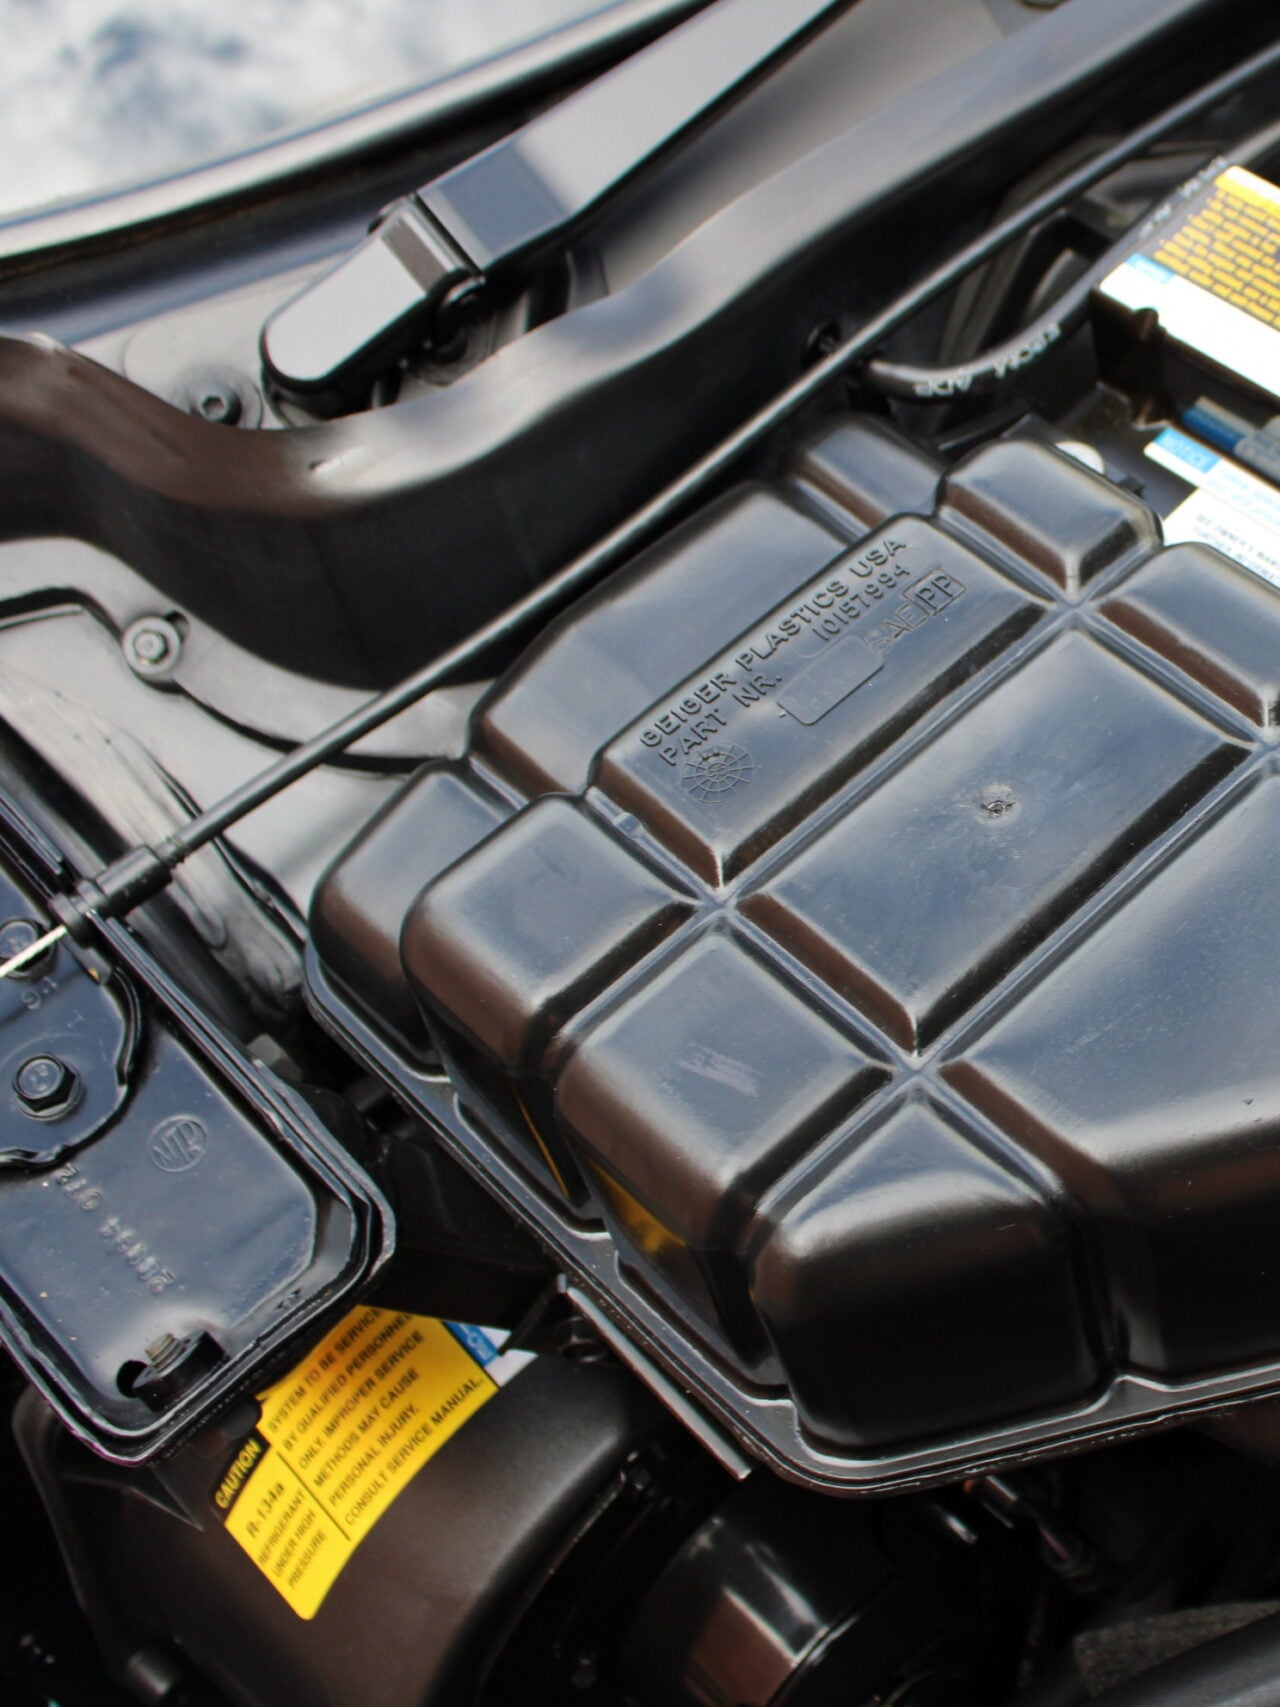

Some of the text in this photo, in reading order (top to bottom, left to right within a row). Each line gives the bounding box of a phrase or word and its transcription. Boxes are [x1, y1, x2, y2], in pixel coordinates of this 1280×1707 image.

[640, 538, 906, 748] GEIGER PLASTICS USA
[659, 709, 728, 767] PART
[265, 1385, 307, 1433] SYSTEM
[303, 1368, 322, 1388] TO
[317, 1351, 336, 1371] BE
[281, 1431, 299, 1450] BY
[293, 1372, 349, 1435] QUALIFIED
[321, 1377, 377, 1438] IMPROPER
[373, 1329, 425, 1380] SERVICE
[312, 1367, 420, 1488] METHODS MAY CAUSE
[214, 1439, 263, 1509] CAUTION
[244, 1480, 285, 1538] R-134a
[327, 1446, 380, 1506] PERSONAL
[343, 1471, 390, 1527] CONSULT
[388, 1421, 435, 1474] SERVICE
[256, 1488, 307, 1565] REFRIGERANT
[271, 1509, 316, 1576] UNDER HIGH
[284, 1528, 327, 1586] PRESSURE
